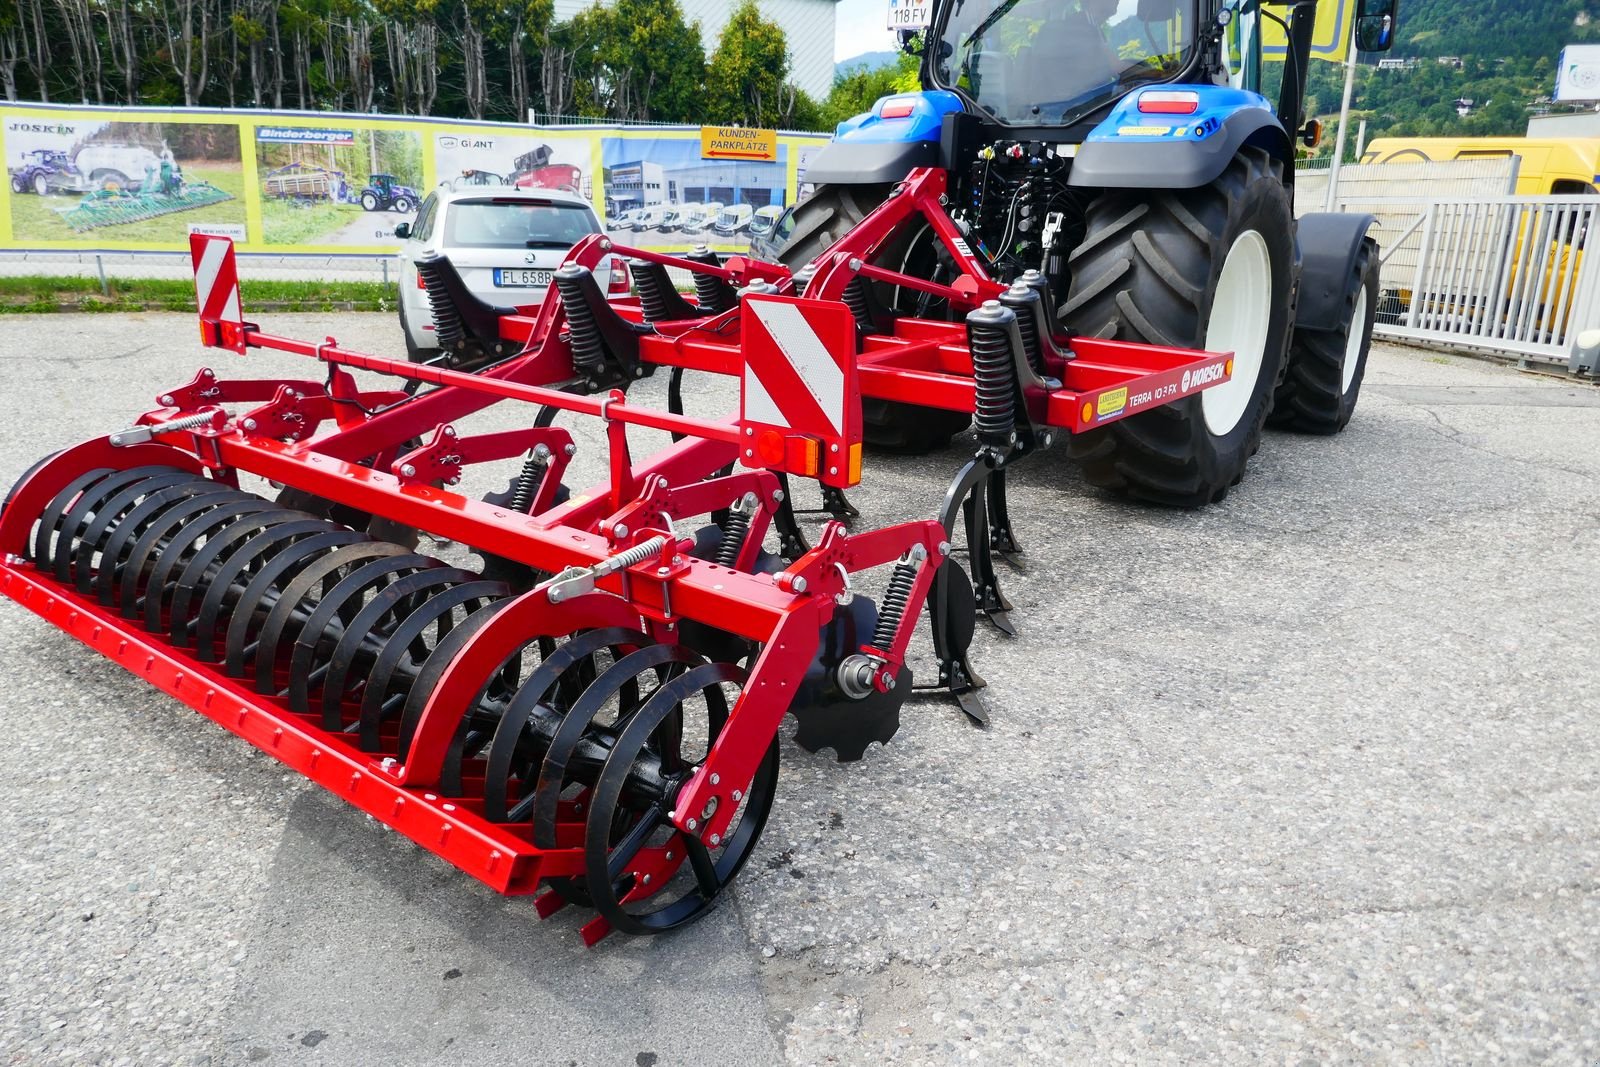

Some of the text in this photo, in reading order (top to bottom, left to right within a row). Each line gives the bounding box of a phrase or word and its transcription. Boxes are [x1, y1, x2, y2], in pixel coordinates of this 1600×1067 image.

[894, 8, 927, 23] 118 FV
[9, 123, 75, 136] JOSKIN
[260, 129, 351, 141] Binderberger
[718, 129, 761, 138] KUNDEN-
[710, 140, 768, 151] PARKPLÄTZE
[503, 271, 517, 284] FL
[1190, 363, 1225, 388] HORSCH
[1129, 391, 1152, 407] TERRA
